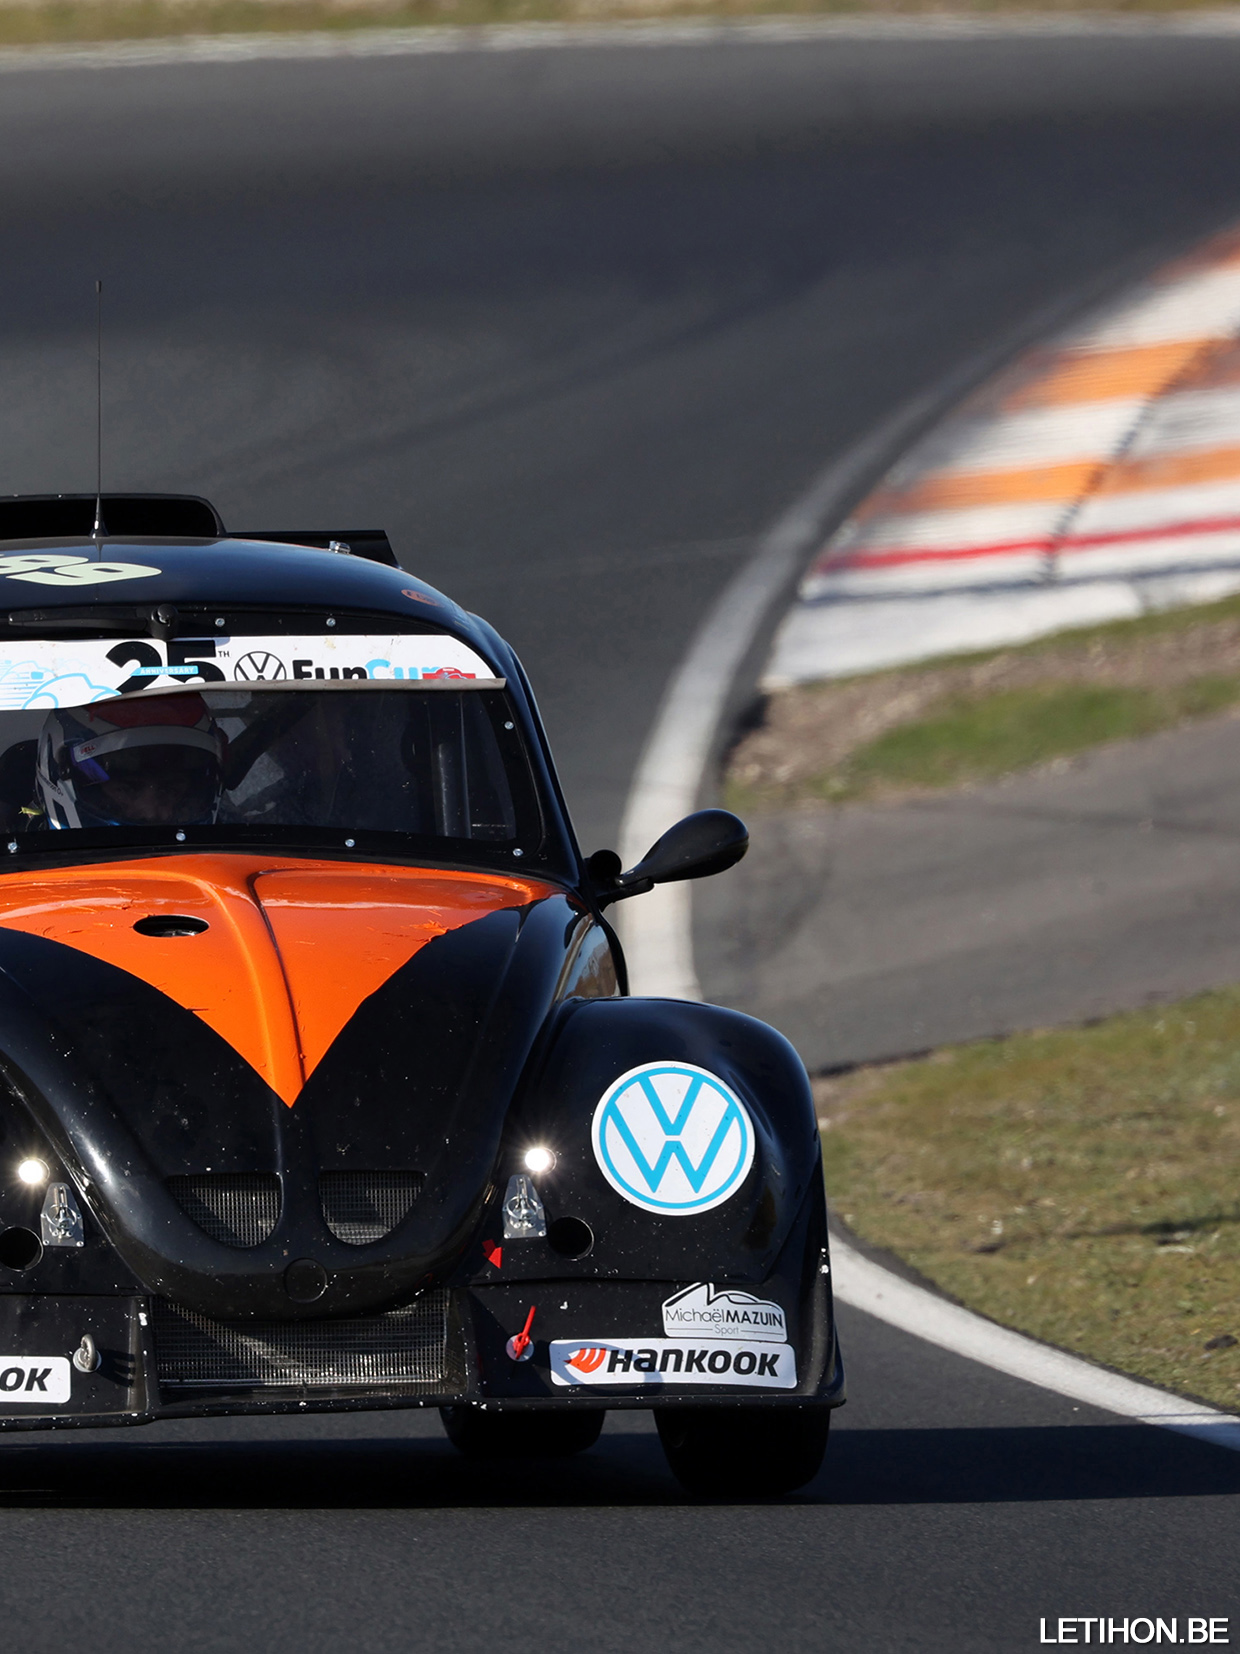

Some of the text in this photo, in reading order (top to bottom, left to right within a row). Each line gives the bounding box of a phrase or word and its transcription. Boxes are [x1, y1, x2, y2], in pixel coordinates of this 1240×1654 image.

[105, 640, 226, 695] 25
[140, 667, 194, 675] ANNIVERSARY
[714, 1324, 739, 1336] Sport
